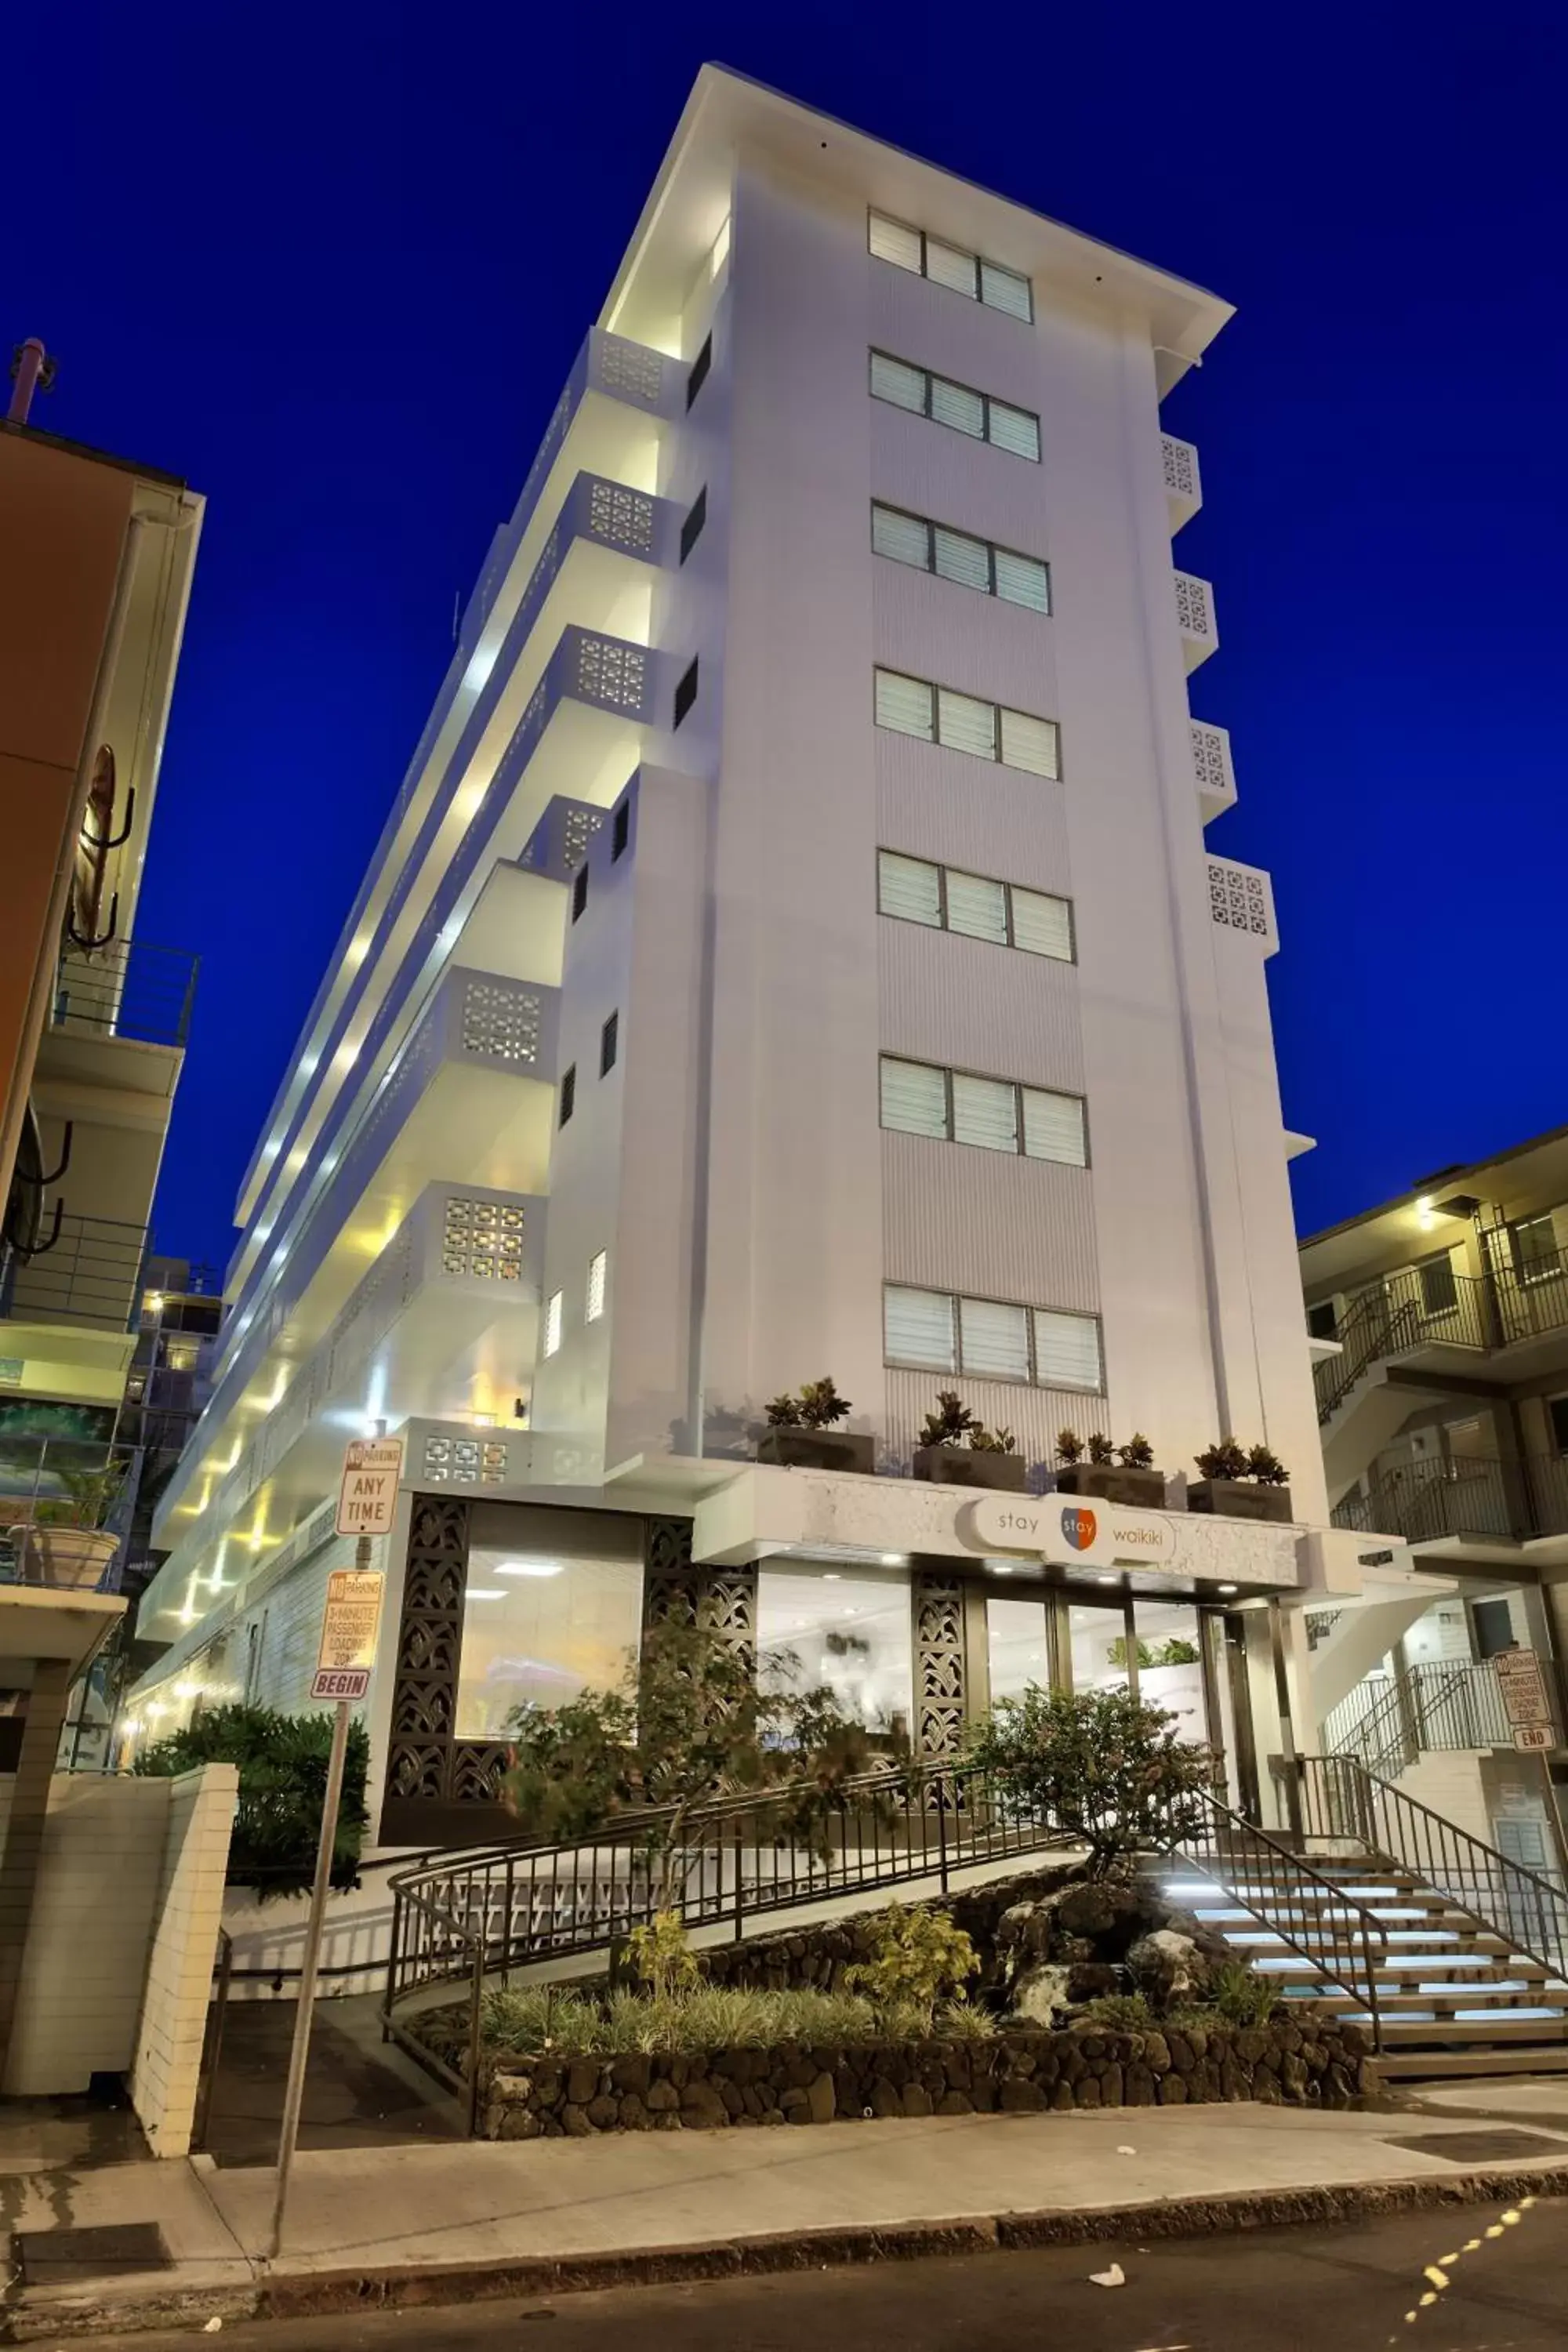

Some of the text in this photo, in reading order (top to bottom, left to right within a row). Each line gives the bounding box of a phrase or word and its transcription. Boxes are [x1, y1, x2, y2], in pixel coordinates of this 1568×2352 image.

[354, 1477, 385, 1494] ANY
[347, 1501, 385, 1519] TIME
[998, 1512, 1163, 1545] stay waikiki
[1063, 1519, 1092, 1534] stay
[345, 1581, 379, 1593] PARKING
[327, 1622, 373, 1635] PASSENGER
[329, 1637, 367, 1650] LOADING
[316, 1674, 365, 1693] BEGIN
[1522, 1730, 1544, 1746] END
